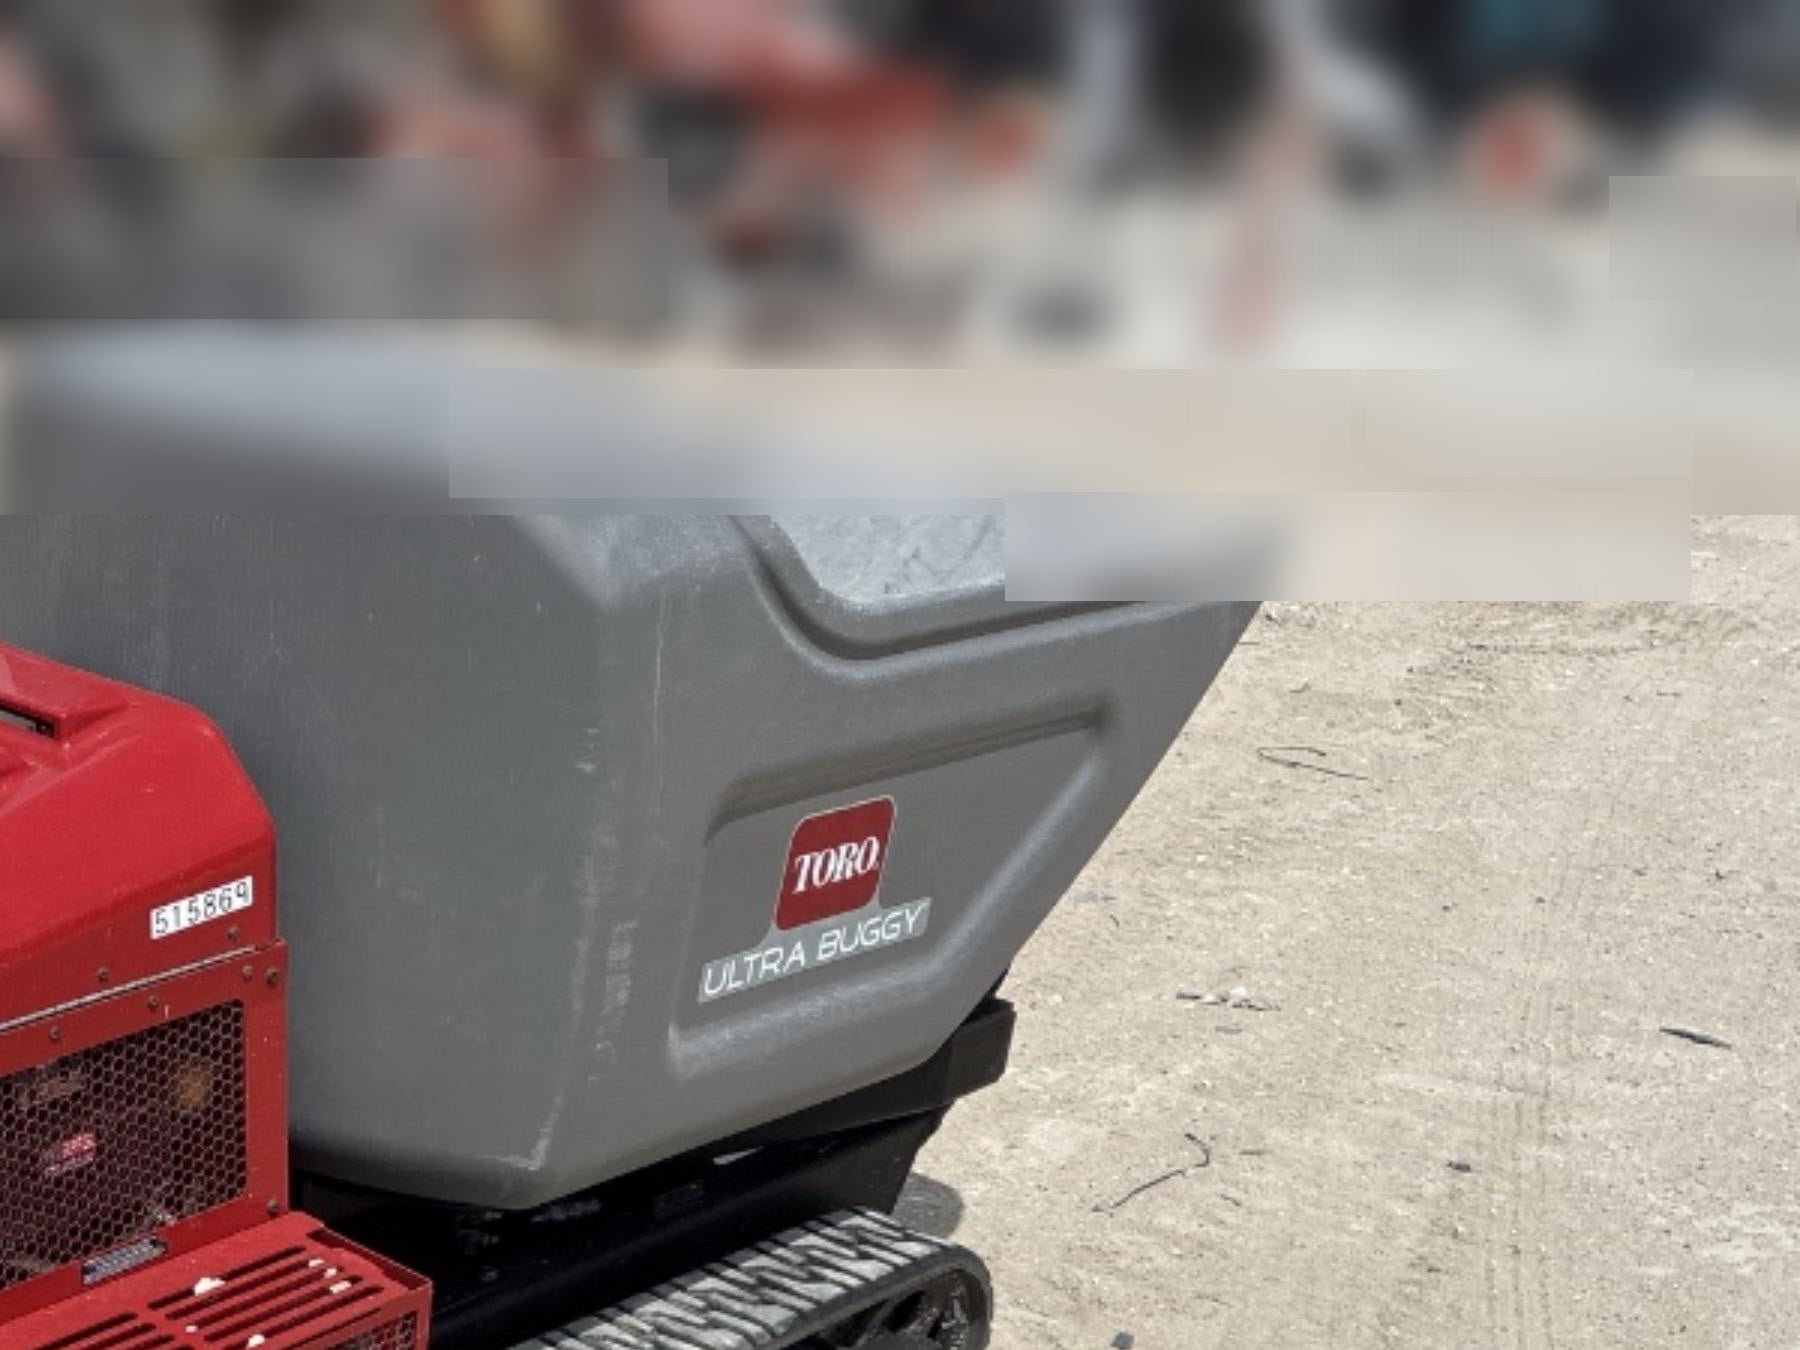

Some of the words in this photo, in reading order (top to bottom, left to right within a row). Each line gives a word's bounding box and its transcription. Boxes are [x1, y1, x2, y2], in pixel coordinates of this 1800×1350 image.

[792, 836, 880, 894] TORO
[155, 881, 248, 935] 515869
[704, 941, 806, 995] ULTRA
[817, 905, 922, 961] BUGGY
